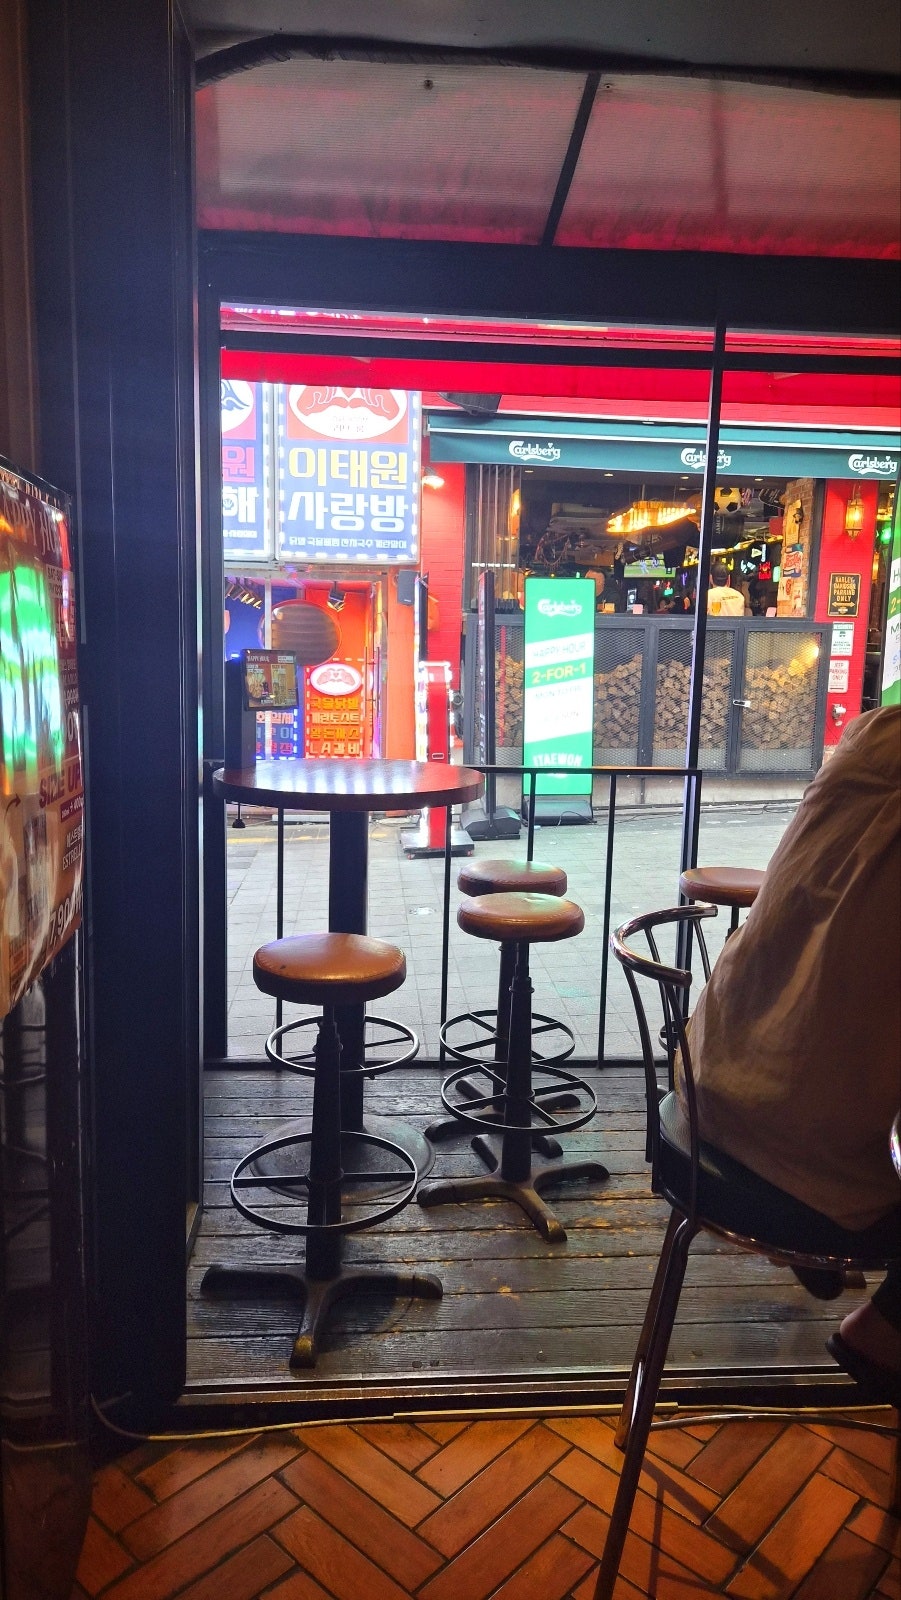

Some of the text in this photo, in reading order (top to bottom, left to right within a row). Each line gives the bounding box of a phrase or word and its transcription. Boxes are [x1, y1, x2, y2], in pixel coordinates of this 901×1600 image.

[508, 440, 561, 461] Carlsberg
[680, 448, 731, 469] Carlsrg
[288, 447, 408, 490] 이태원
[848, 454, 898, 475] Carlsberg
[287, 491, 409, 533] 사랑방
[532, 662, 587, 684] 2-FOR-1
[533, 752, 583, 767] ITAEWON
